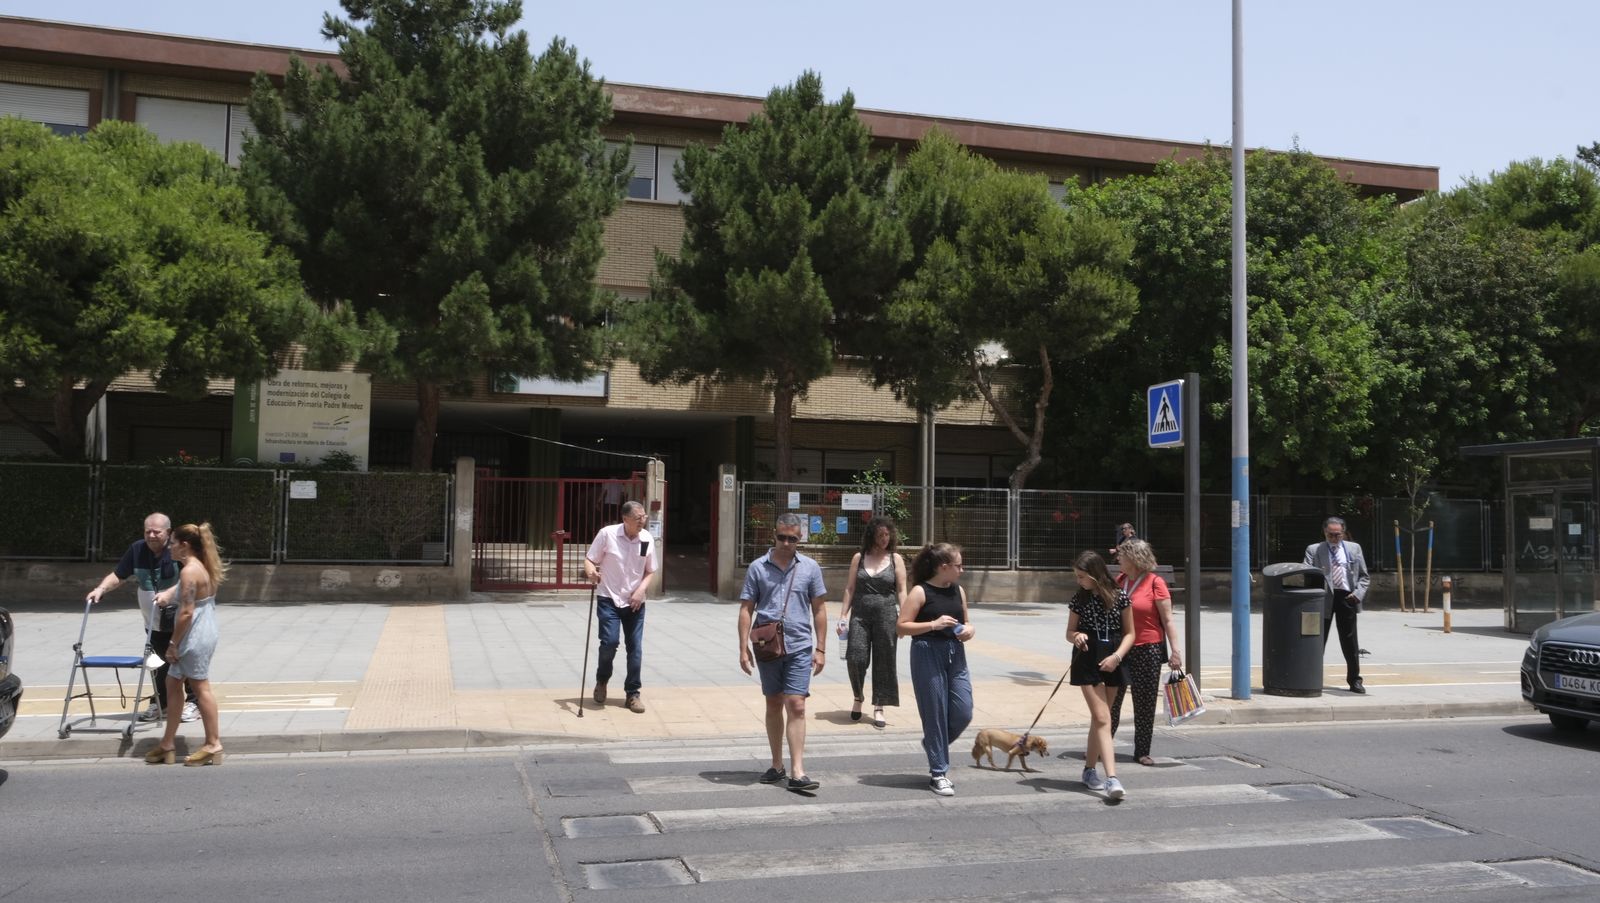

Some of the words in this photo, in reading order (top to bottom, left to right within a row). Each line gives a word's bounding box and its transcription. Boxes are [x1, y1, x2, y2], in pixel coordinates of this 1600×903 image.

[283, 380, 291, 388] de
[320, 383, 343, 391] mejoras
[310, 390, 319, 398] del
[320, 391, 342, 400] Colegio
[343, 392, 351, 400] de
[297, 400, 322, 408] Primaria
[324, 401, 340, 409] Padre
[1562, 677, 1586, 690] 0464
